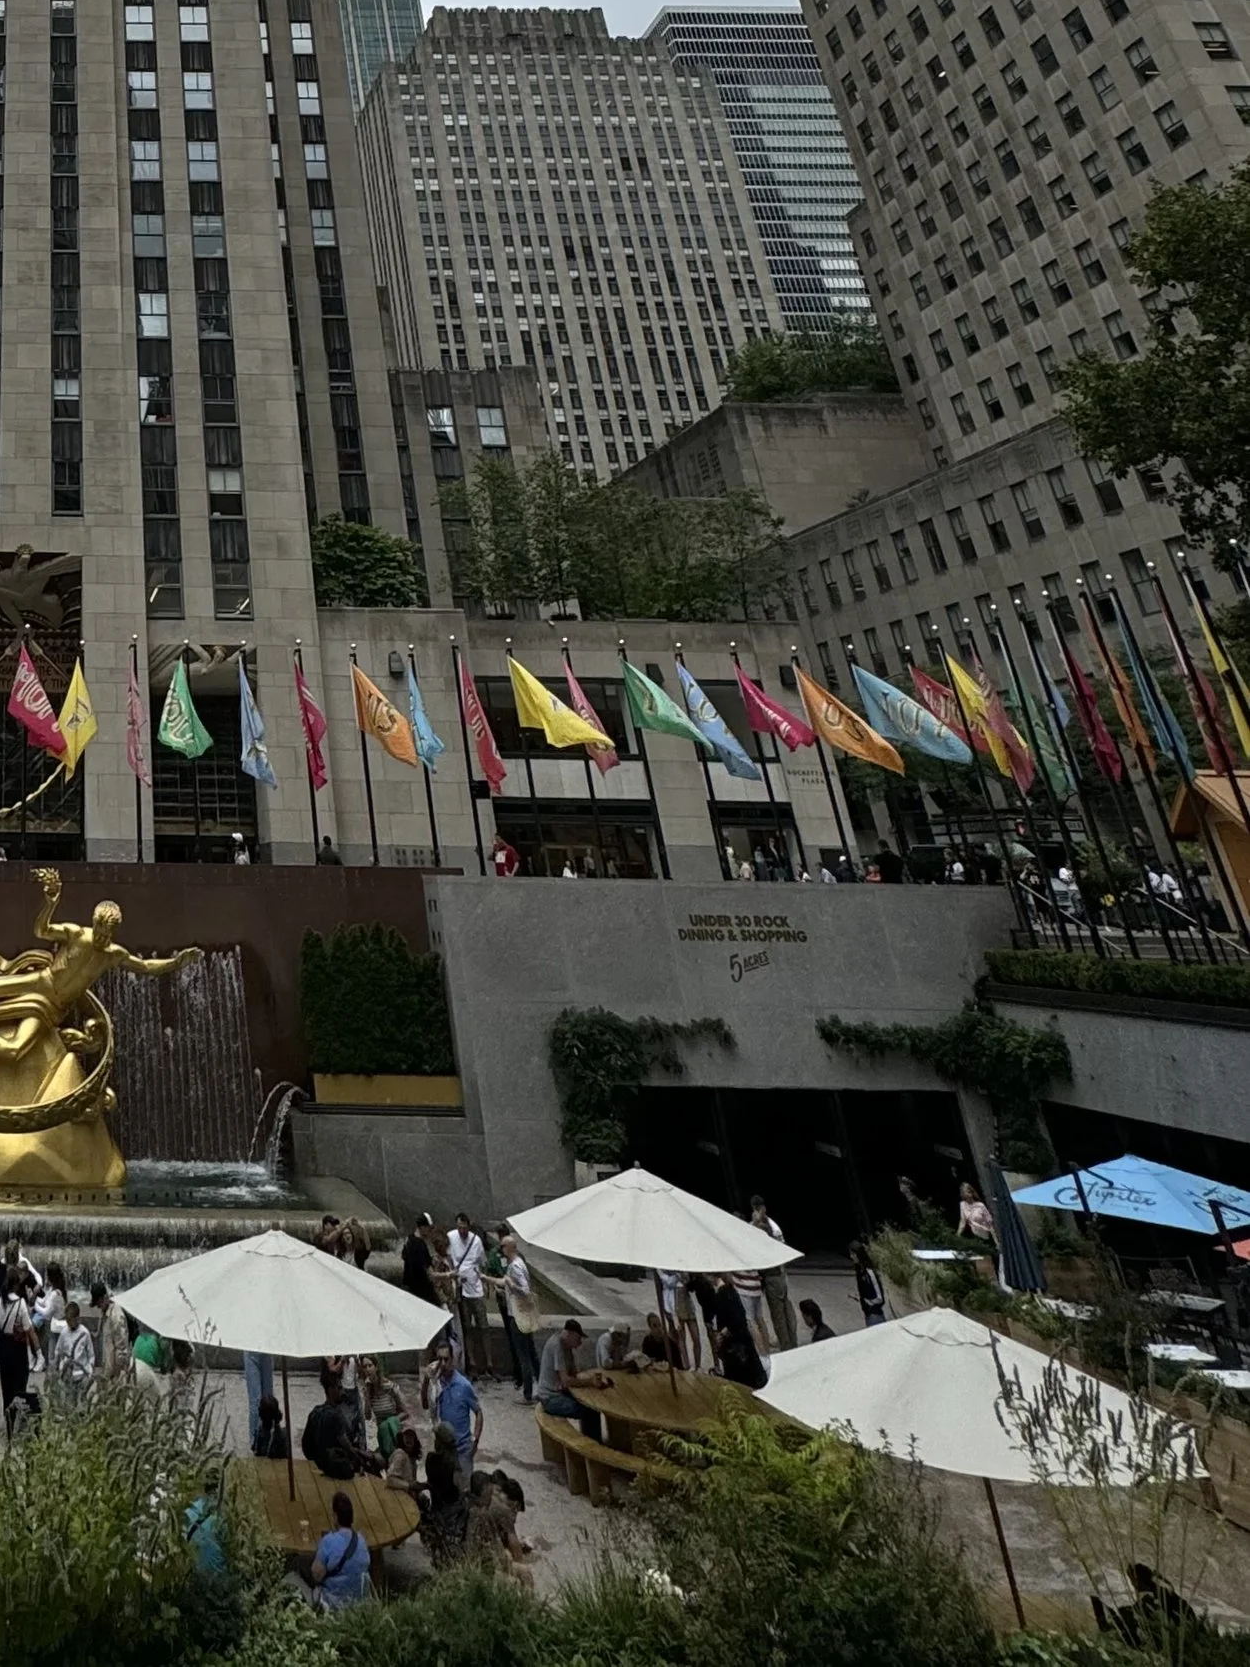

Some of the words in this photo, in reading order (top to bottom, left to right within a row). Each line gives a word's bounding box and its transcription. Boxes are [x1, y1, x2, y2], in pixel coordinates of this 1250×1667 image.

[689, 914, 732, 927] UNDER
[735, 916, 751, 927] 30
[754, 915, 790, 928] ROCK
[678, 928, 725, 941] DINING
[728, 930, 737, 942] &
[741, 930, 807, 943] SHOPPING
[729, 953, 743, 983] 5
[743, 951, 770, 970] ACRES
